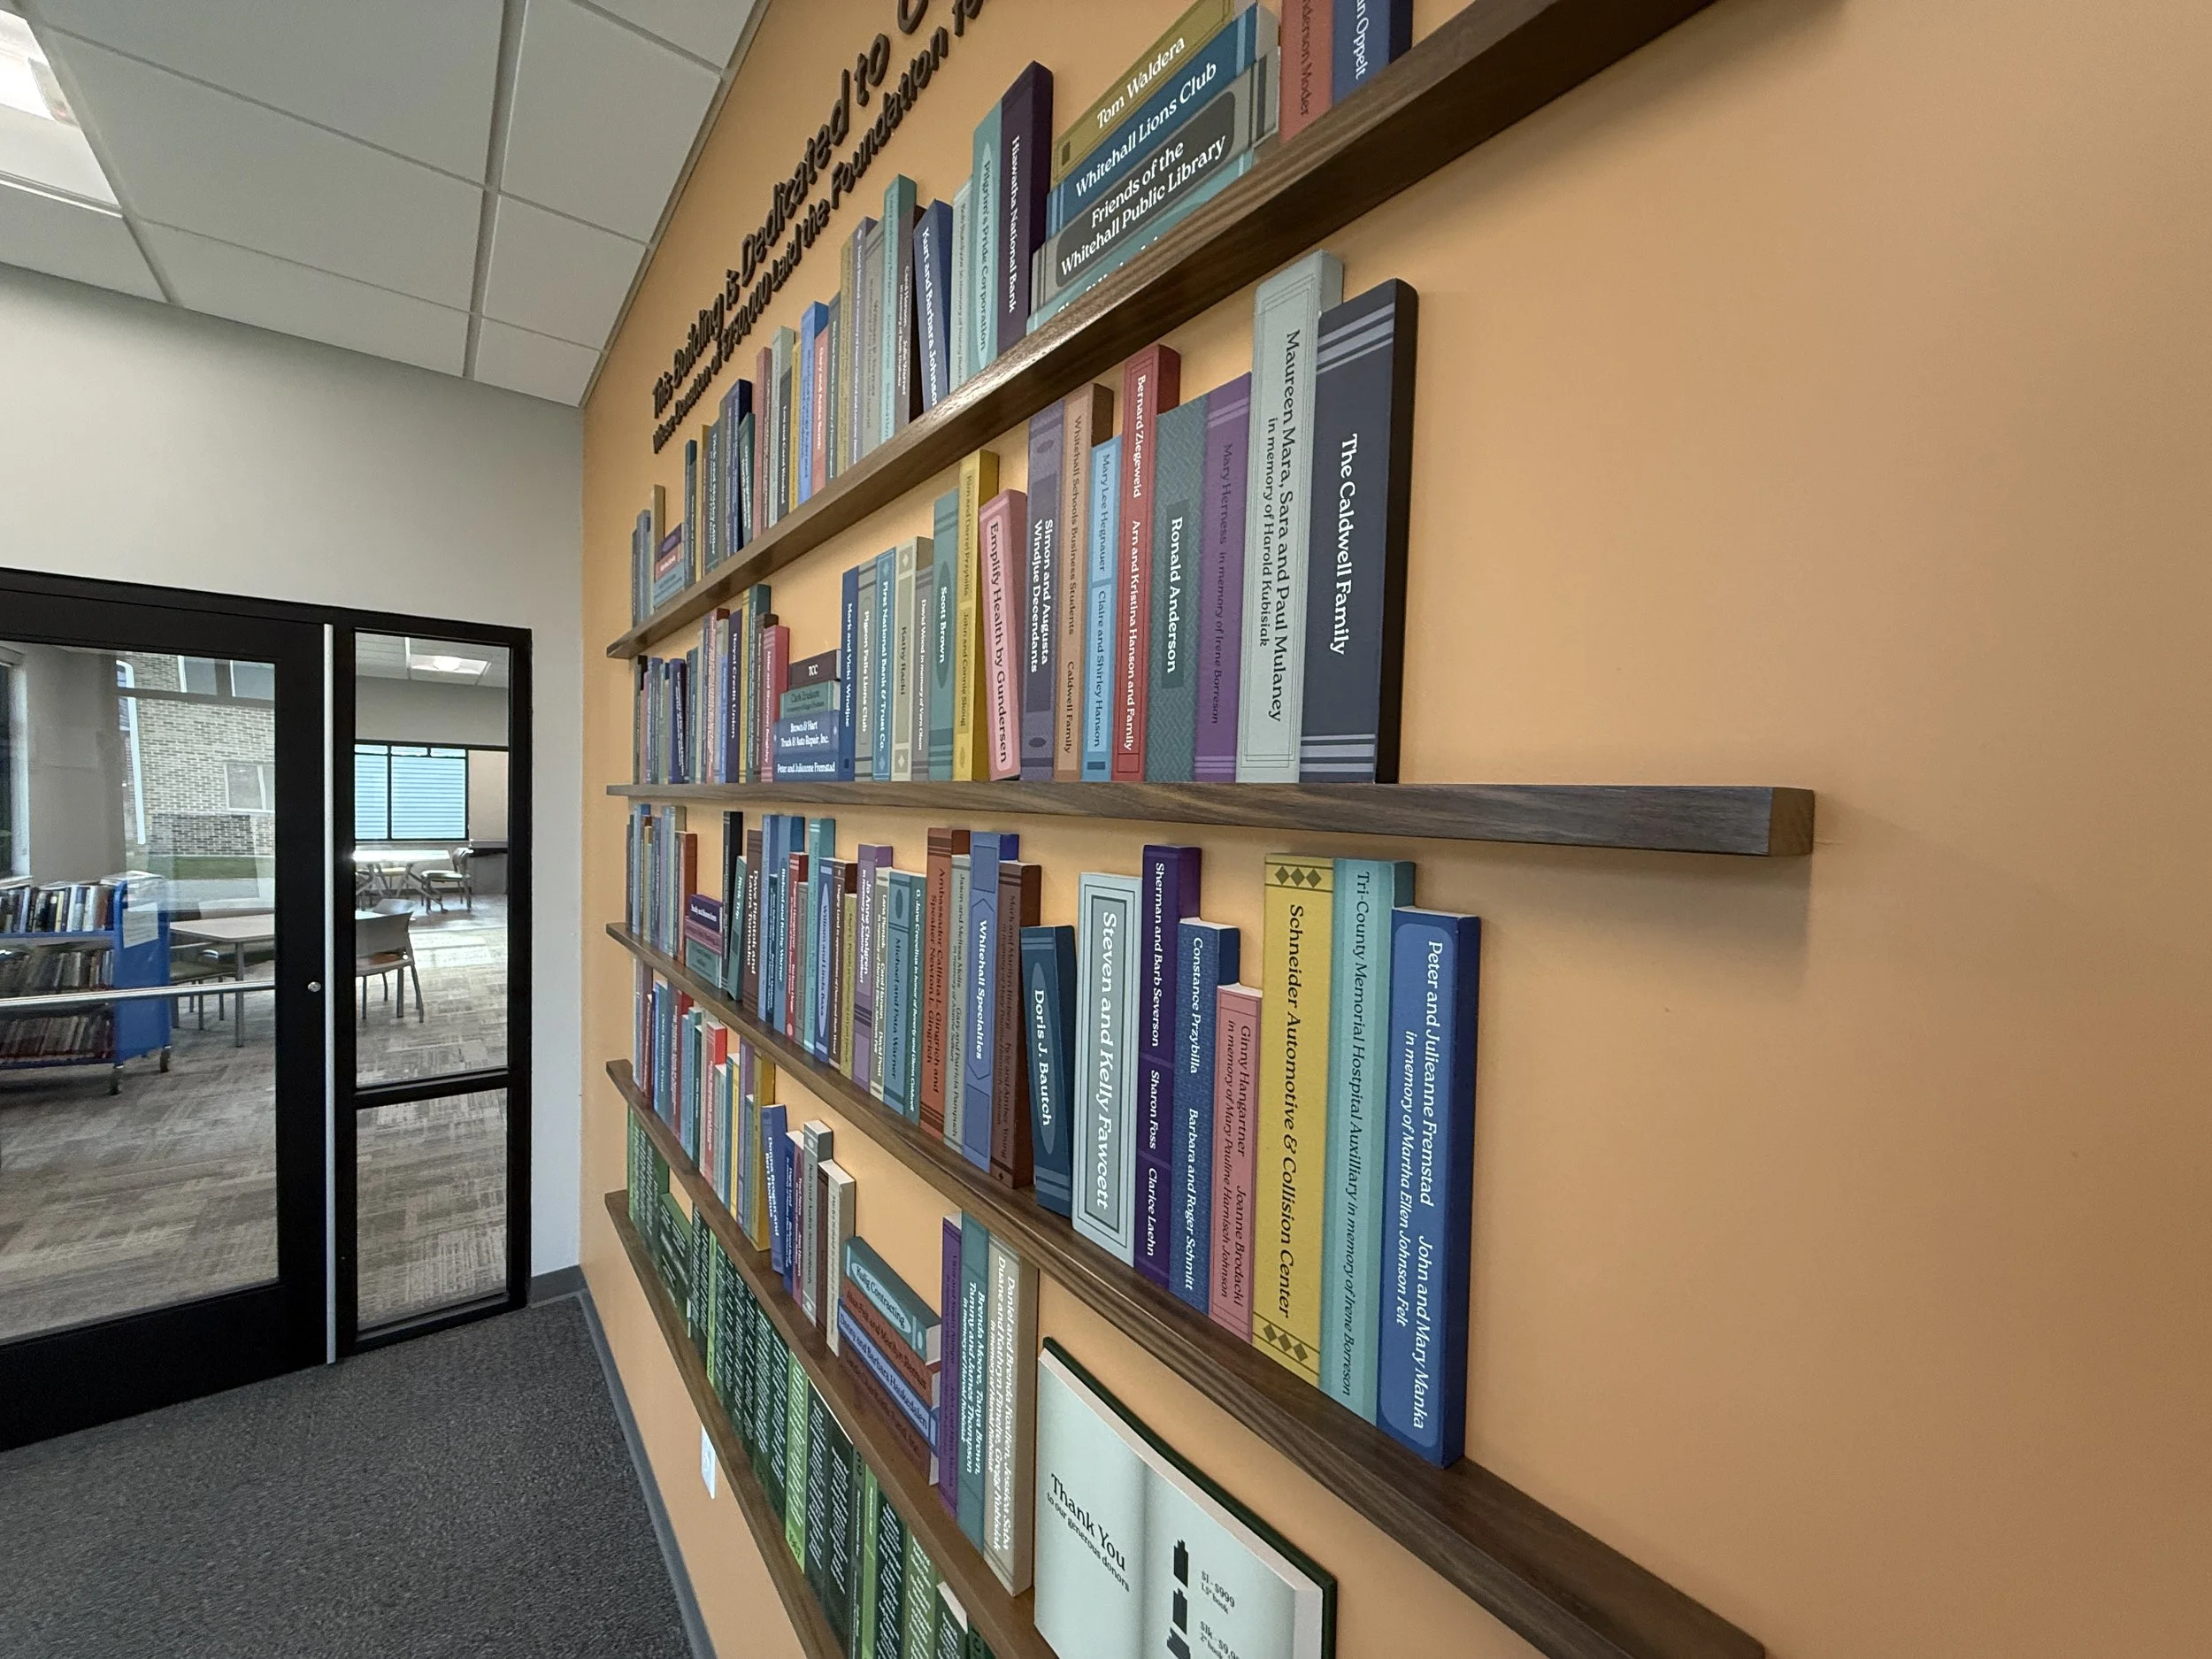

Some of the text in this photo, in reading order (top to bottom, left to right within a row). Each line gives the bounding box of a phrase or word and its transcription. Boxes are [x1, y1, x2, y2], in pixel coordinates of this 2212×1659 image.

[1097, 37, 1186, 129] Tom Waldera
[1301, 65, 1312, 116] Moder
[1354, 17, 1369, 80] Oppelt
[800, 198, 830, 249] the
[831, 26, 949, 210] Foundation
[1010, 135, 1020, 209] Hiawatha
[1075, 61, 1217, 198] Whitehall Lions Club
[652, 371, 673, 419] This
[672, 293, 725, 389] Building
[726, 269, 740, 310] is
[741, 68, 849, 288] Dedicated
[854, 33, 890, 107] to
[981, 160, 991, 223] Pilgrim's
[1061, 135, 1226, 276] Whitehall Public Library
[1091, 141, 1184, 228] Friends of the
[924, 264, 933, 291] and
[1010, 209, 1018, 273] National
[926, 292, 935, 349] Barbara
[979, 265, 988, 351] Corporation
[1125, 375, 1147, 750] Bernard Ziegeweid Arn and Kristina Hanson and Family
[1259, 418, 1278, 647] in memory of Harold Kubisiak
[1268, 330, 1301, 721] Maureen Mara, Sara and Paul Mulaney
[1331, 434, 1358, 654] The Caldwell Family
[1031, 519, 1042, 672] Windjue Decendants
[1041, 519, 1054, 664] Simon and Augusta
[1167, 517, 1183, 672] Ronald Anderson
[990, 523, 1008, 763] Emplify Health by Gundersen
[879, 690, 887, 699] &
[1154, 926, 1164, 952] and
[1155, 863, 1164, 923] Sherman
[975, 920, 987, 1060] Whitehall Specialties
[1151, 987, 1162, 1048] Severson
[1153, 954, 1163, 985] Barb
[1035, 990, 1052, 1125] Doris J. Bautch
[1096, 912, 1117, 1210] Steven and Kelly Fawcett
[1150, 1070, 1160, 1117] Sharon
[1149, 1120, 1158, 1149] Foss
[1185, 938, 1203, 1290] Constance Przybilla Barbara and Roger Schmitt
[1279, 904, 1304, 1319] Schneider Automotive & Collision Center
[1341, 872, 1370, 1396] Tri-County Memorial Hostpital Auxilliary in memory of Irene Borreson
[1148, 1168, 1157, 1215] Clarice
[1233, 1025, 1251, 1307] Ginny Hangartner Joanne Brodacki
[1396, 1031, 1417, 1326] in memory of Martha Ellen Johnson Felt
[1411, 941, 1443, 1429] Peter and Julieanne Fremstad John and Mary Manka
[870, 1282, 906, 1328] Contracting
[967, 1281, 977, 1328] Tammy
[973, 1292, 986, 1475] Brenda Moore, Tanya Brown,
[964, 1405, 974, 1472] Thompson
[1047, 1492, 1130, 1593] to our generous donors
[1051, 1472, 1126, 1571] Thank You
